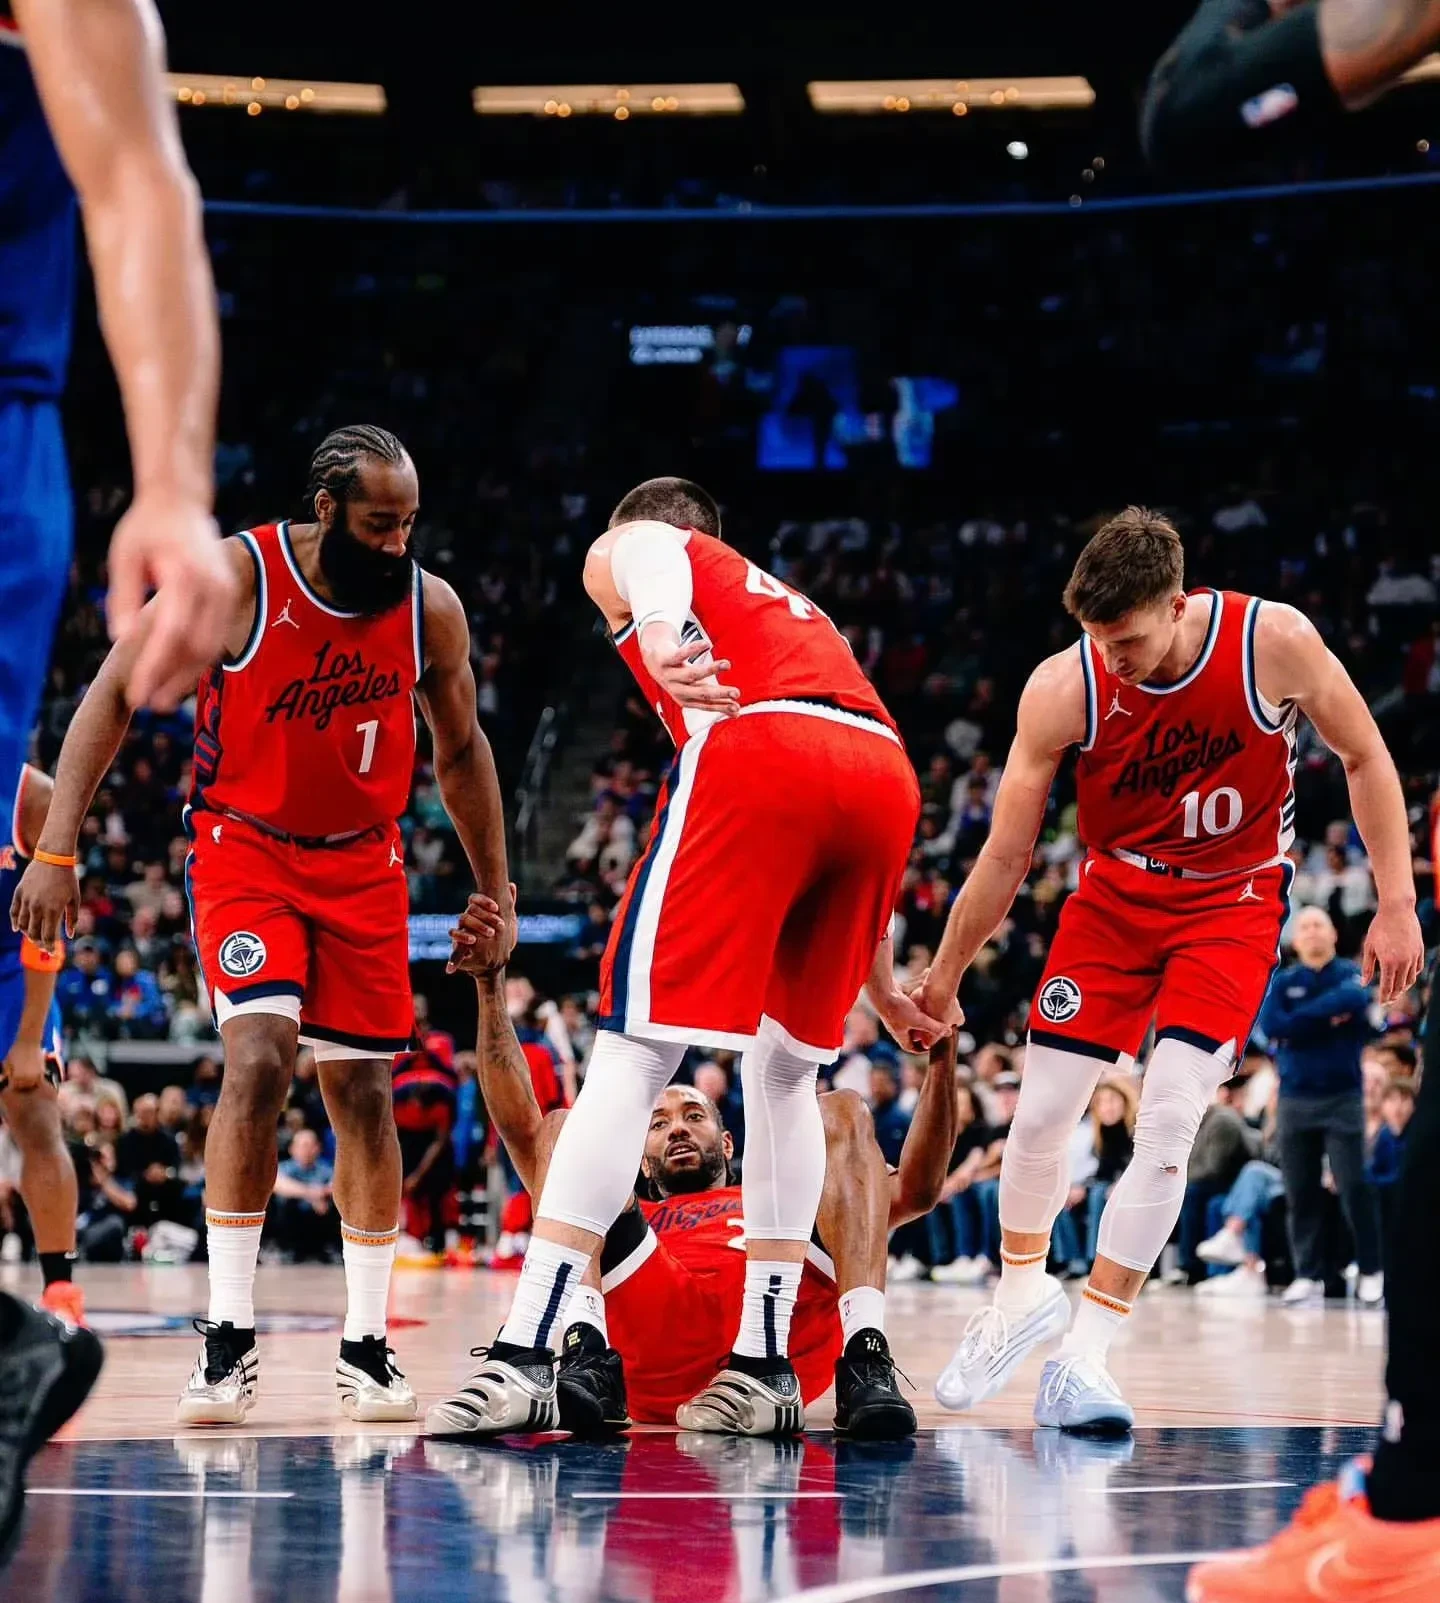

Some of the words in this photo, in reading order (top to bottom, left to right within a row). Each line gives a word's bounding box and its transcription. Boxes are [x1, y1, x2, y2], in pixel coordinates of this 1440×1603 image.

[309, 640, 367, 684] Los
[265, 664, 401, 731] Angeles
[355, 719, 379, 773] 1
[1109, 727, 1246, 798] Angeles
[1146, 719, 1199, 762] Los
[1180, 786, 1243, 838] 10
